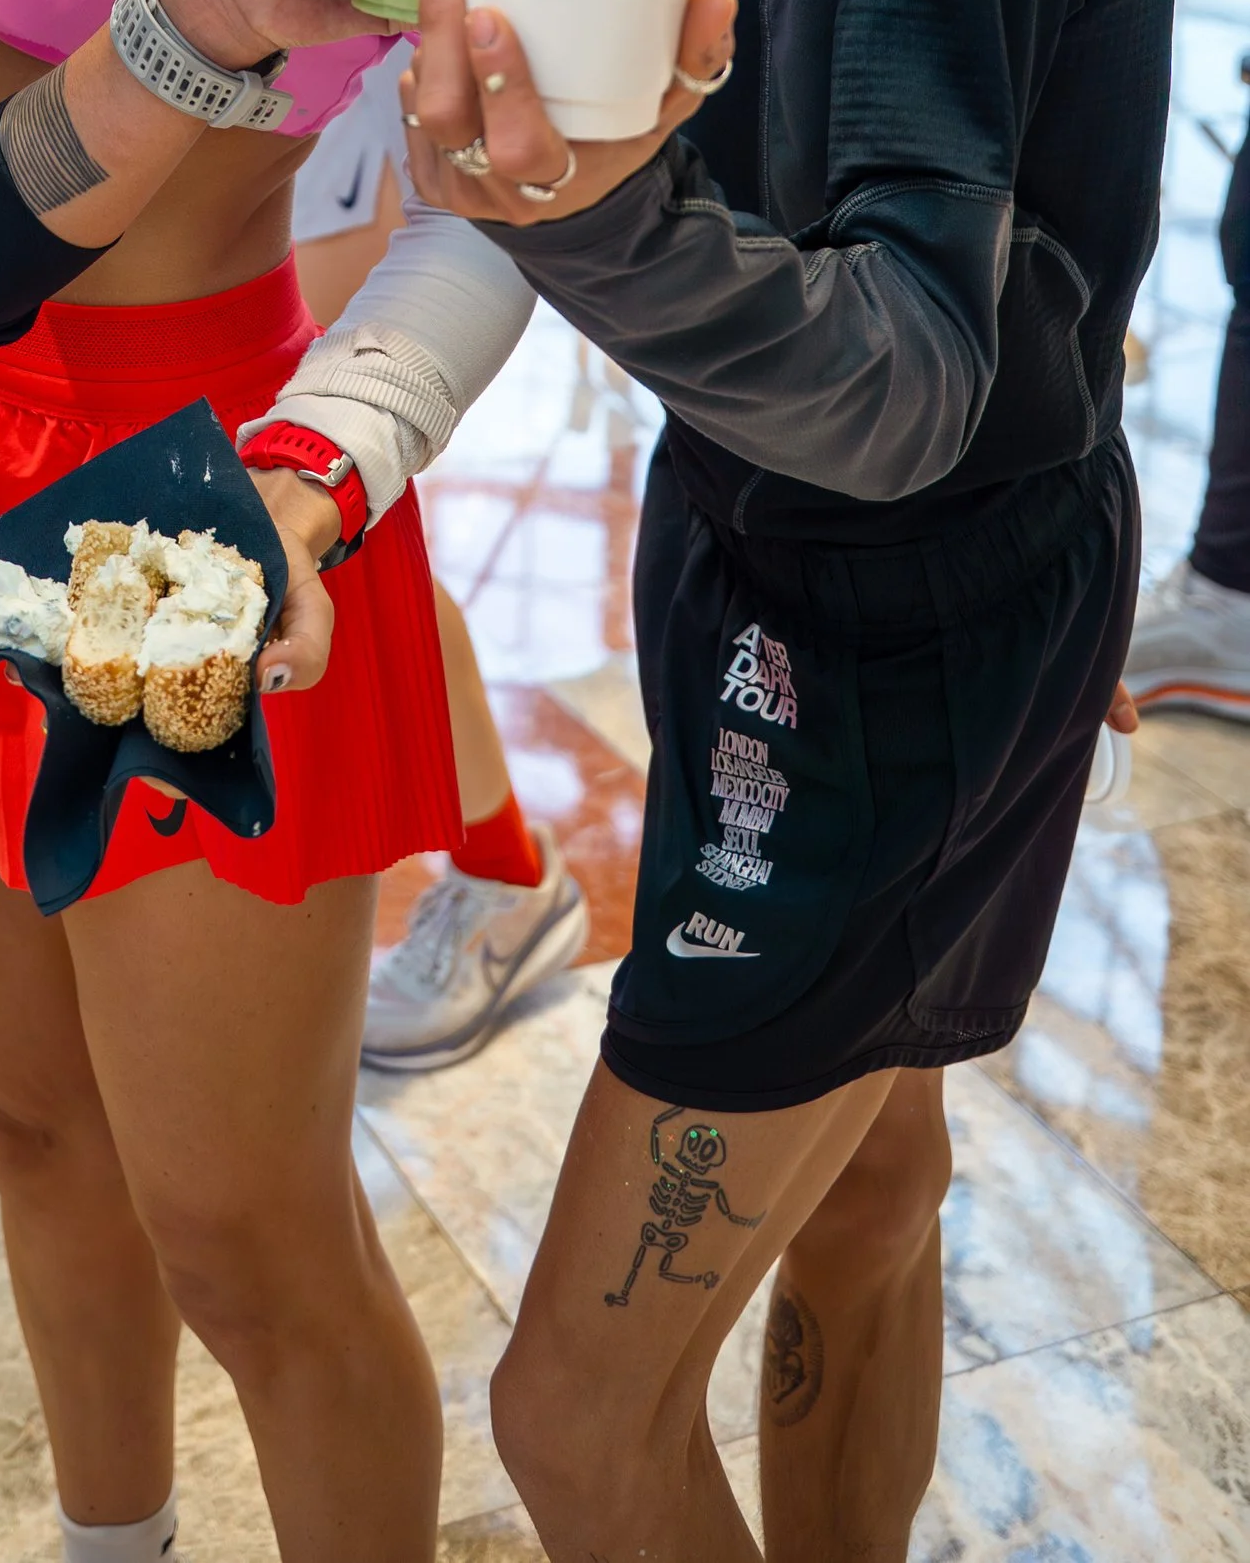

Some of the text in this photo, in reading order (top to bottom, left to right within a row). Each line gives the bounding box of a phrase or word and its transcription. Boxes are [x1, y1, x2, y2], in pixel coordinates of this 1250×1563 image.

[727, 648, 798, 699] DARK
[719, 672, 798, 729] TOUR
[718, 727, 769, 767] LONDON
[718, 798, 775, 834] MUMBAI
[721, 825, 761, 858] SEOUL
[694, 859, 758, 891] SYDNEY
[699, 842, 773, 885] SHANGHAI
[685, 911, 746, 952] RUN
